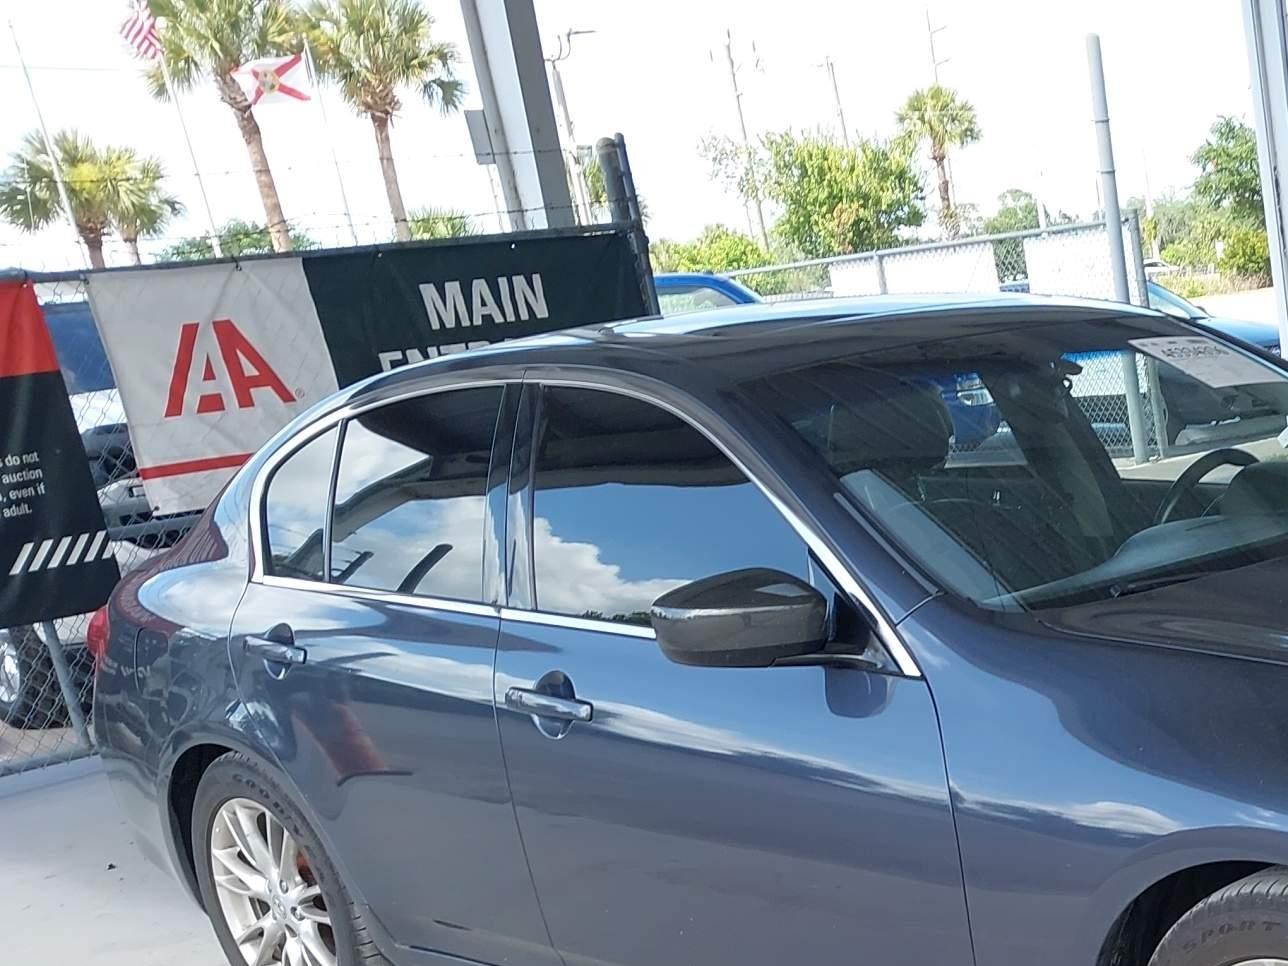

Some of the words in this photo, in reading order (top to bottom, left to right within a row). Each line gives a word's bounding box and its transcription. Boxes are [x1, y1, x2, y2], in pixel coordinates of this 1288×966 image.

[419, 273, 549, 330] MAIN
[5, 454, 20, 466] do
[23, 451, 39, 464] not
[1, 468, 43, 484] auction
[9, 486, 35, 499] even
[36, 482, 45, 495] if
[3, 503, 32, 518] adult.
